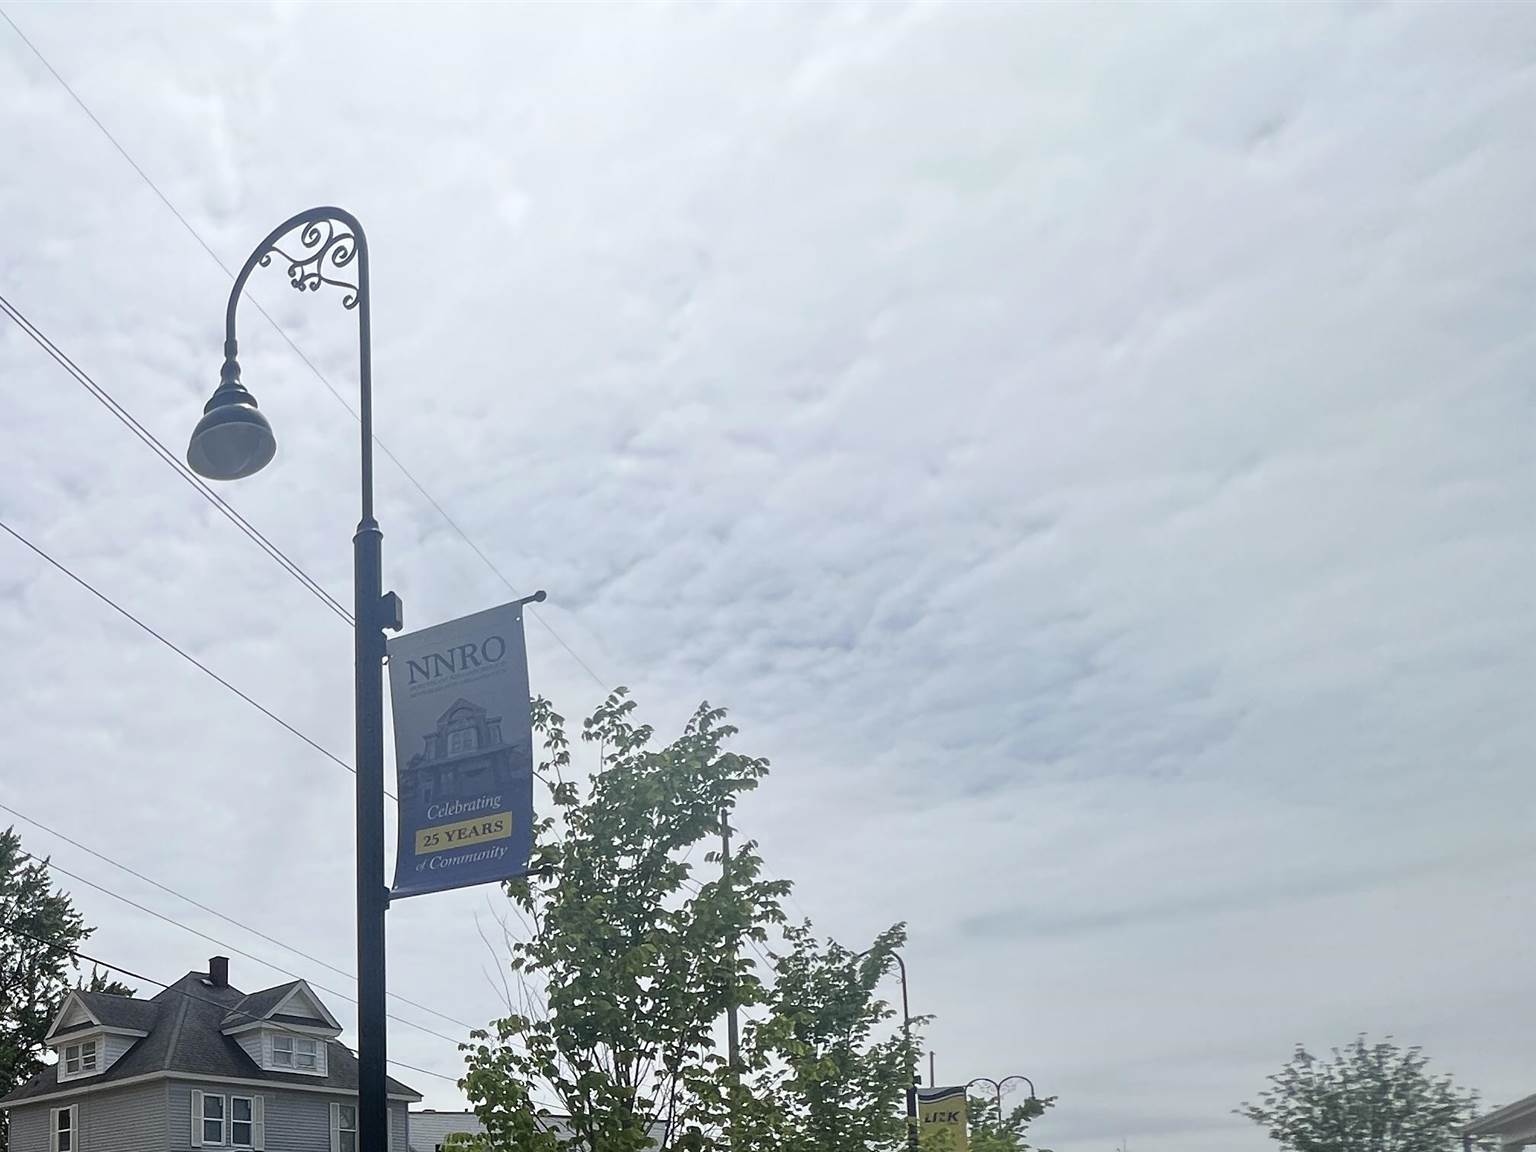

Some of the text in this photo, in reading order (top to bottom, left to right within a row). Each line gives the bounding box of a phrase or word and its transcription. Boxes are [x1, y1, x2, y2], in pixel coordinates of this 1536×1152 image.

[405, 635, 506, 685] NNRO
[426, 795, 503, 820] Celebrating
[423, 820, 504, 848] 25 YEARS
[415, 846, 508, 872] of Community
